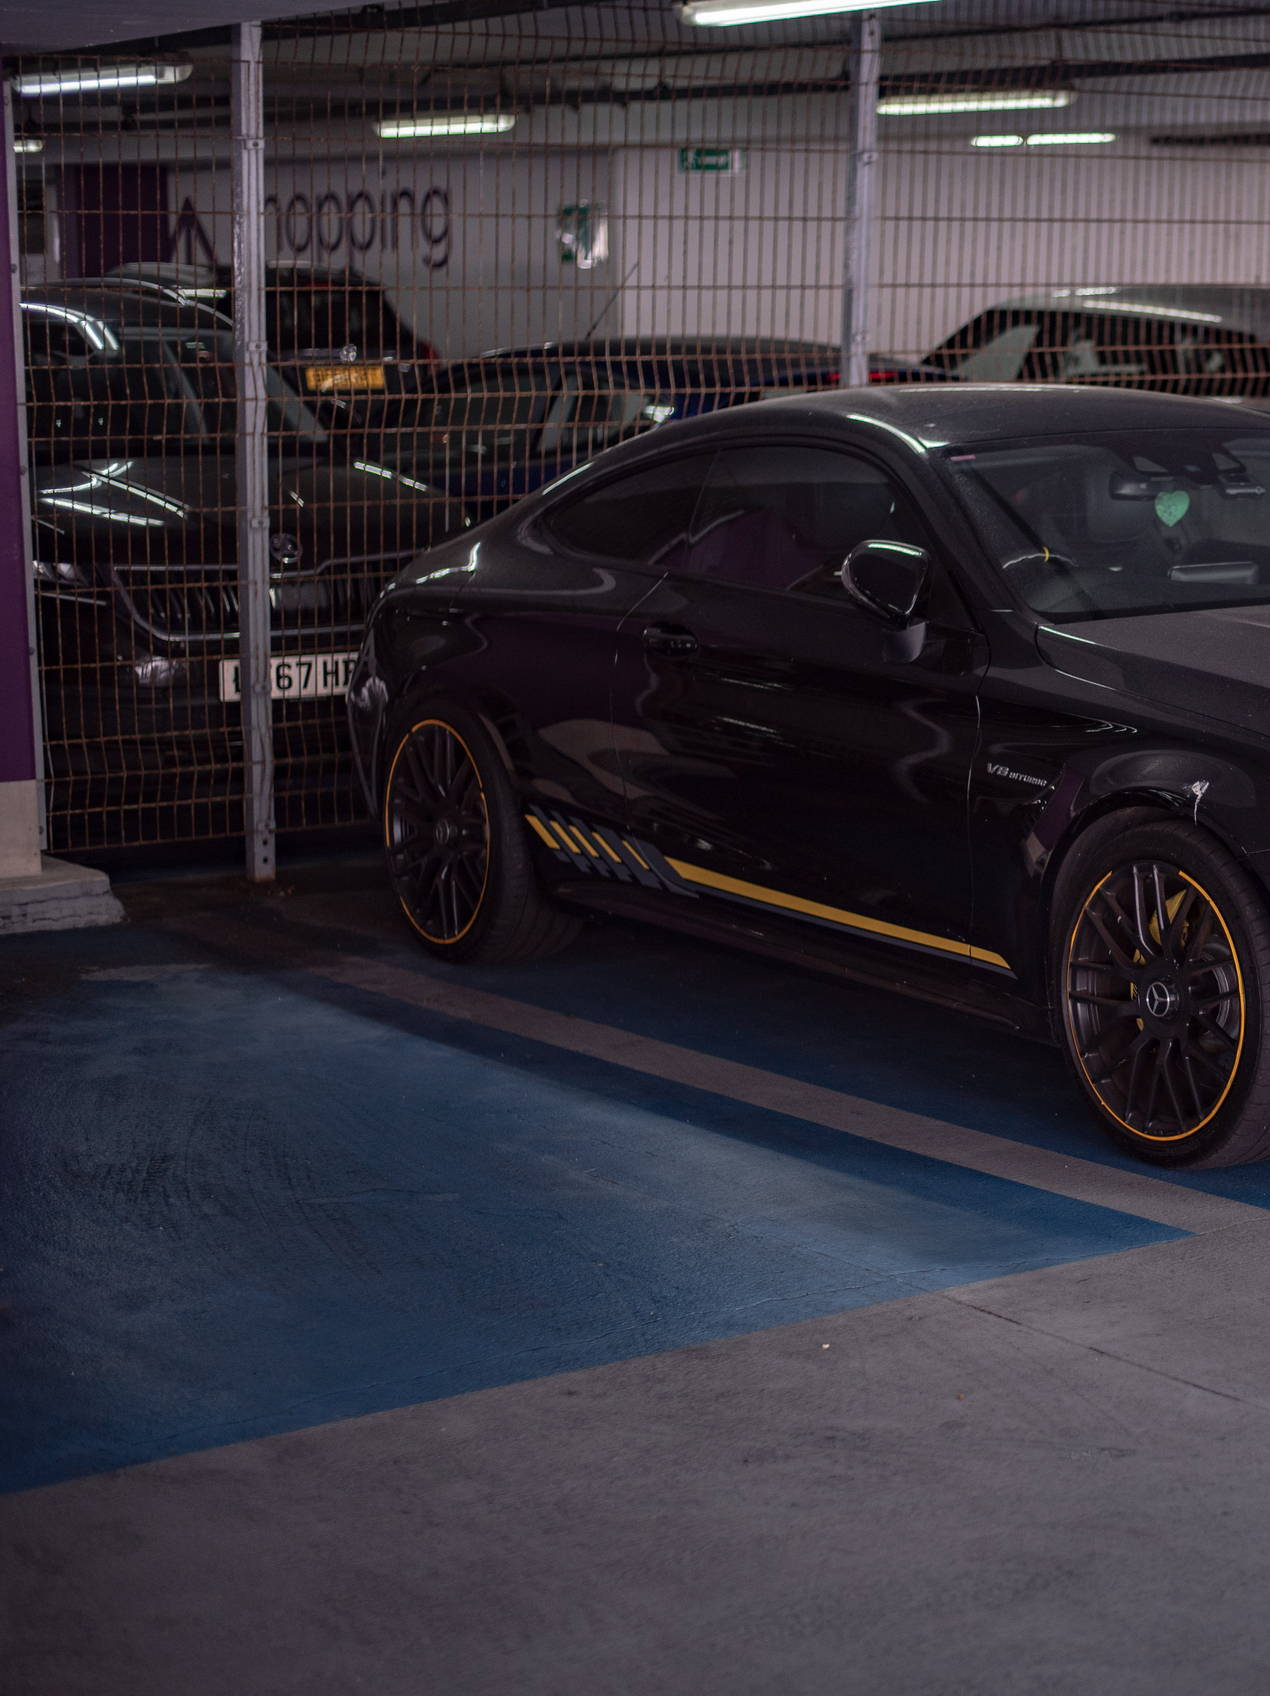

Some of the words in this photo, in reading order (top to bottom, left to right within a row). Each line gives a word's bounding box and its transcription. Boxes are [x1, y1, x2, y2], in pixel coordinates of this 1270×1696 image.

[263, 164, 451, 269] opping
[986, 761, 1010, 777] V8
[1009, 771, 1048, 787] BITURBO
